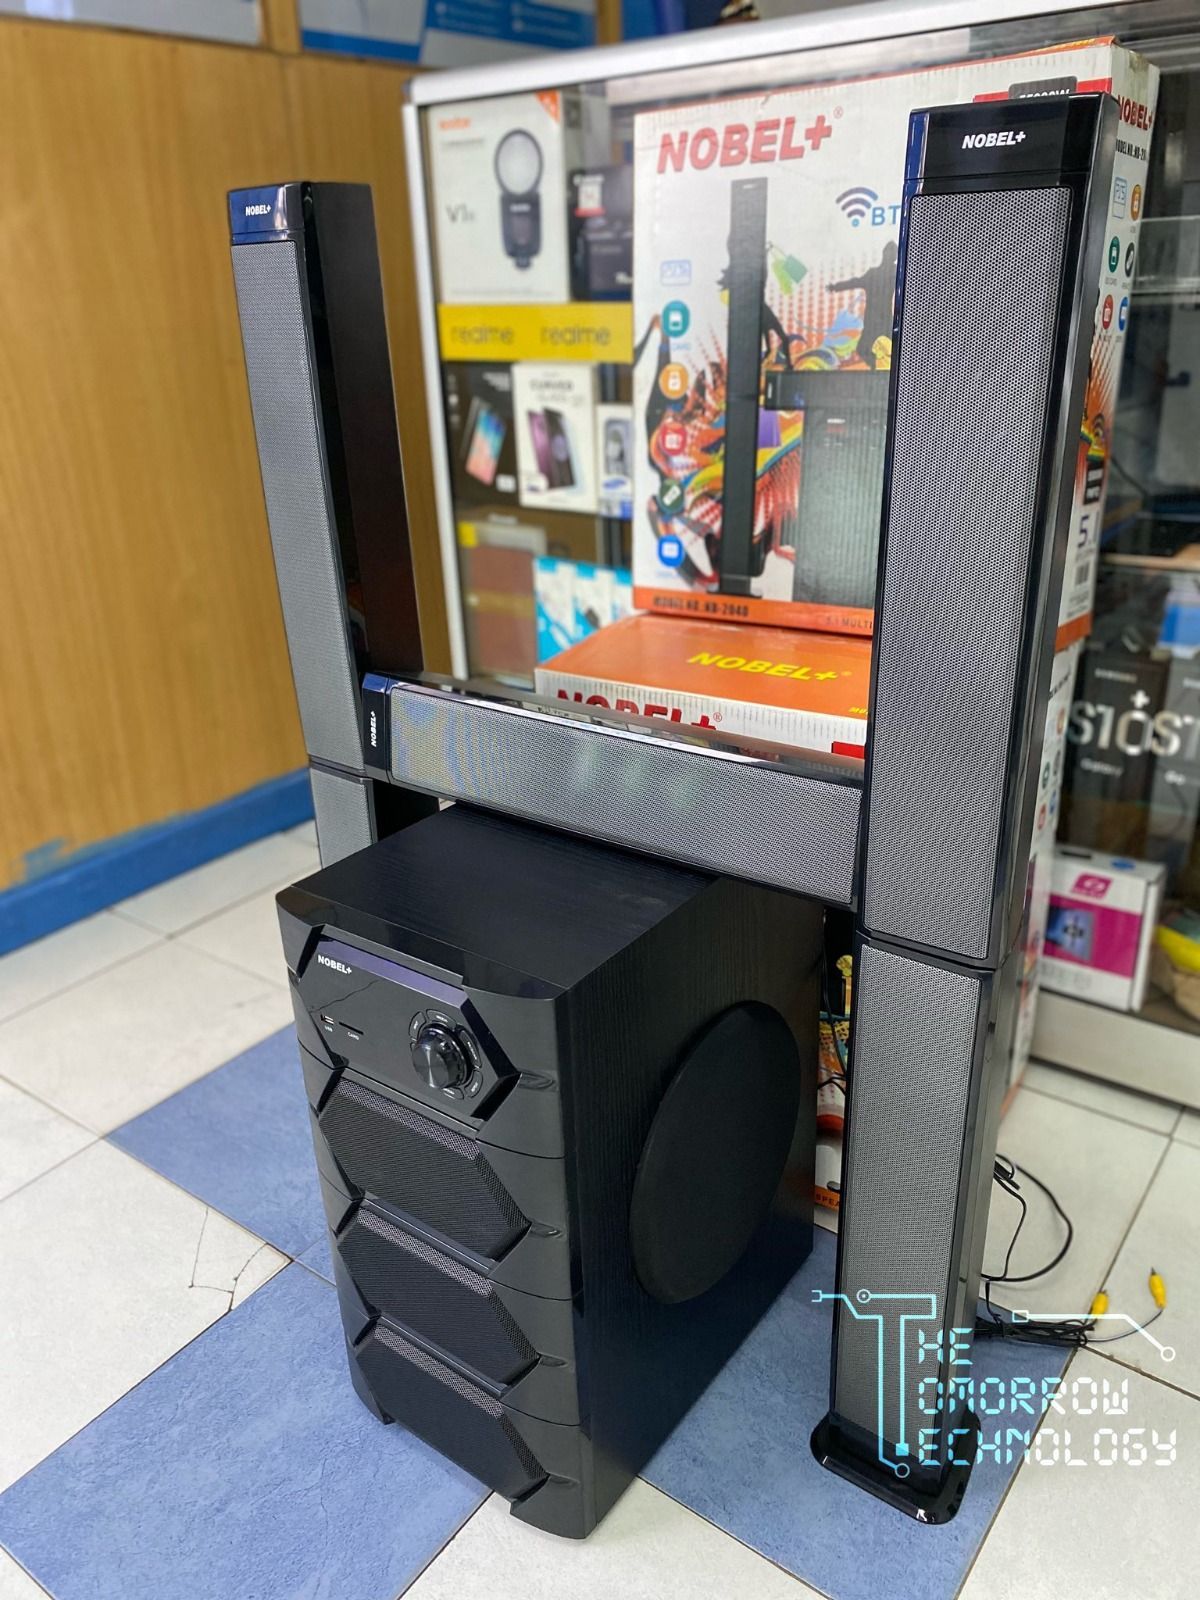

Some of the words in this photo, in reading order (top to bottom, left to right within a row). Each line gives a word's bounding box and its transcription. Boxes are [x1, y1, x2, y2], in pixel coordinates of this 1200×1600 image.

[657, 115, 832, 174] NOBEL+
[961, 130, 1026, 150] NOBEL+
[245, 204, 272, 217] NOBEL+
[688, 651, 839, 681] NOBEL+
[317, 954, 353, 976] NOBEL+
